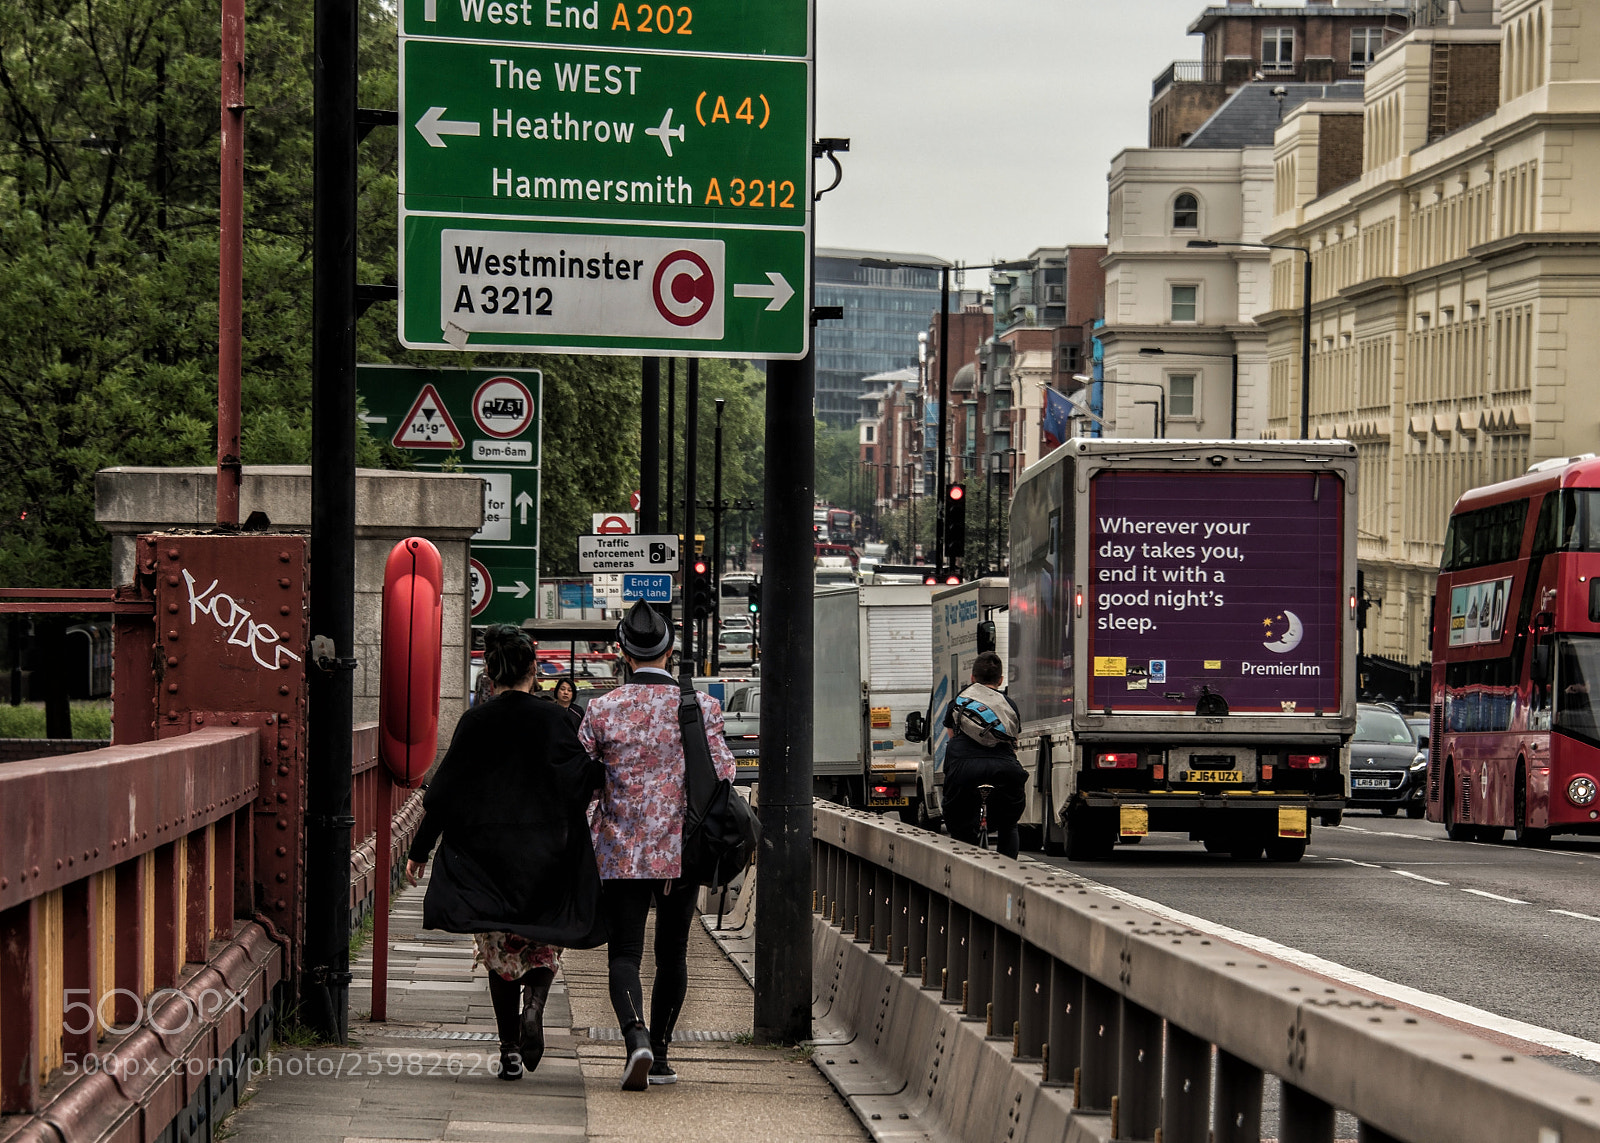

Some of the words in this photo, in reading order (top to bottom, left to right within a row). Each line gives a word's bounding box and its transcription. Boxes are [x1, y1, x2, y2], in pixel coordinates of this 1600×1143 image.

[460, 0, 531, 25] West
[546, 0, 598, 29] End
[490, 59, 541, 90] The
[555, 63, 641, 95] WEST
[493, 109, 634, 143] Heathrow
[493, 168, 692, 205] Hammersmith
[454, 245, 643, 281] Westminster
[478, 445, 527, 457] 9pm-6am
[487, 499, 506, 510] for
[1099, 516, 1199, 535] Wherever
[1203, 522, 1251, 539] your
[597, 539, 630, 548] Traffic
[1099, 541, 1136, 562] day
[1140, 542, 1196, 559] takes
[1201, 547, 1245, 563] you,
[582, 549, 645, 558] enforcement
[593, 560, 635, 568] cameras
[631, 578, 649, 587] End
[652, 578, 663, 587] of
[1098, 565, 1137, 582] end
[1142, 565, 1157, 582] it
[1162, 565, 1207, 583] with
[1213, 570, 1226, 583] a
[646, 588, 668, 598] lane
[1098, 590, 1149, 611] good
[1098, 613, 1157, 634] sleep.
[1189, 772, 1216, 782] FJ64
[1218, 772, 1239, 782] UZX
